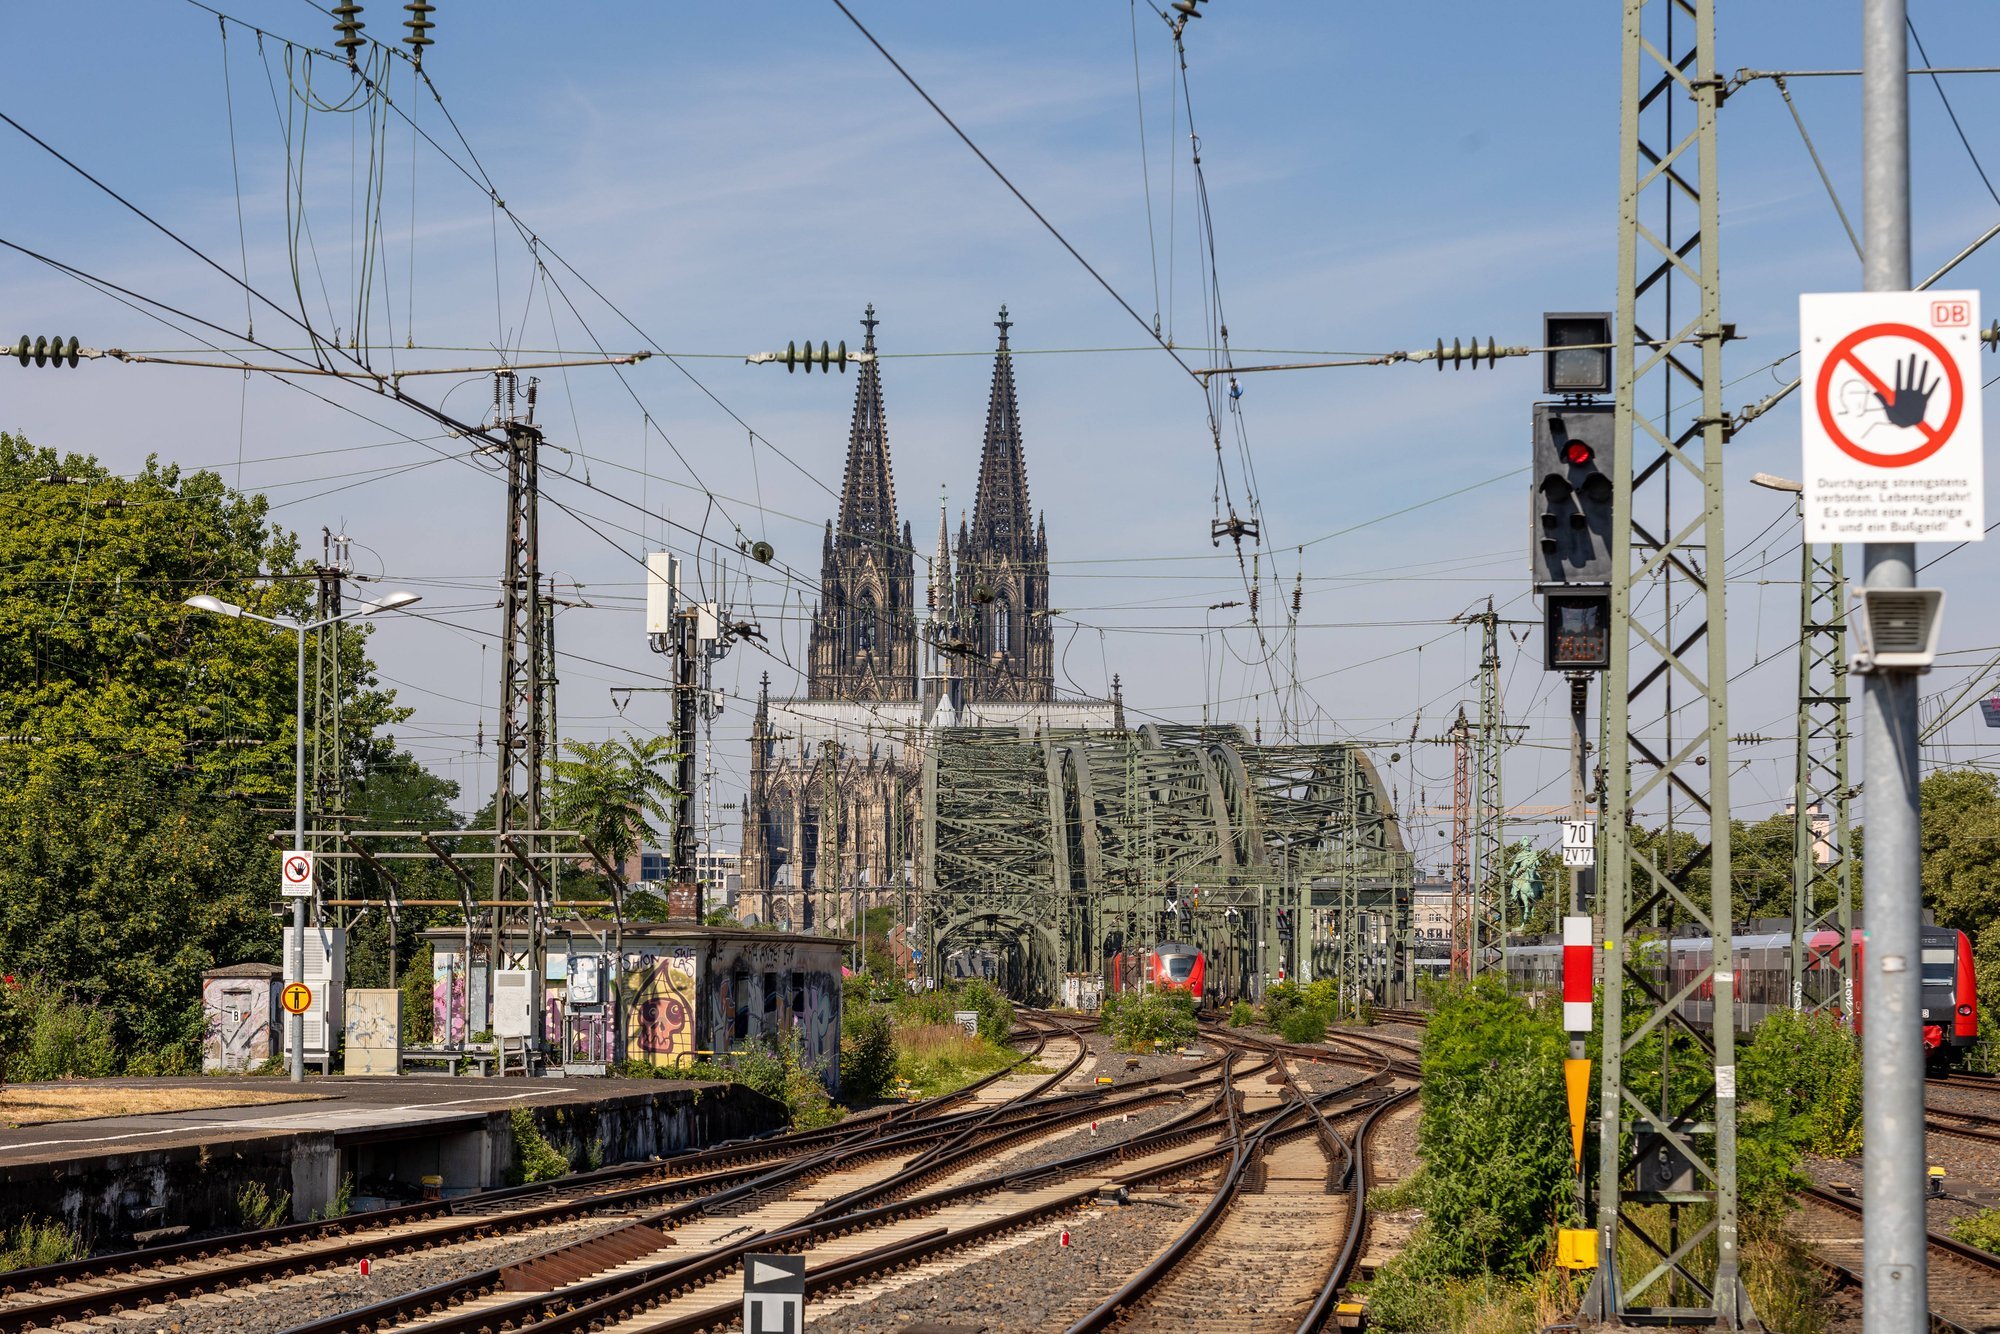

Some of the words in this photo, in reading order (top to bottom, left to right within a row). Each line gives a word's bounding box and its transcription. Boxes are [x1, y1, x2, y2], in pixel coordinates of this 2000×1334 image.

[1935, 304, 1966, 324] DB
[1817, 478, 1888, 490] Durchgang
[1893, 478, 1968, 489] strengstens
[1879, 492, 1971, 503] Lebensgefahr!
[1824, 508, 1839, 518] Es
[1843, 508, 1877, 517] droht
[1882, 508, 1907, 517] eine
[1912, 507, 1962, 519] Anzeige
[1838, 522, 1863, 532] und
[1867, 523, 1886, 532] ein
[1890, 522, 1948, 533] Bußgeld!
[1570, 825, 1586, 844] 70
